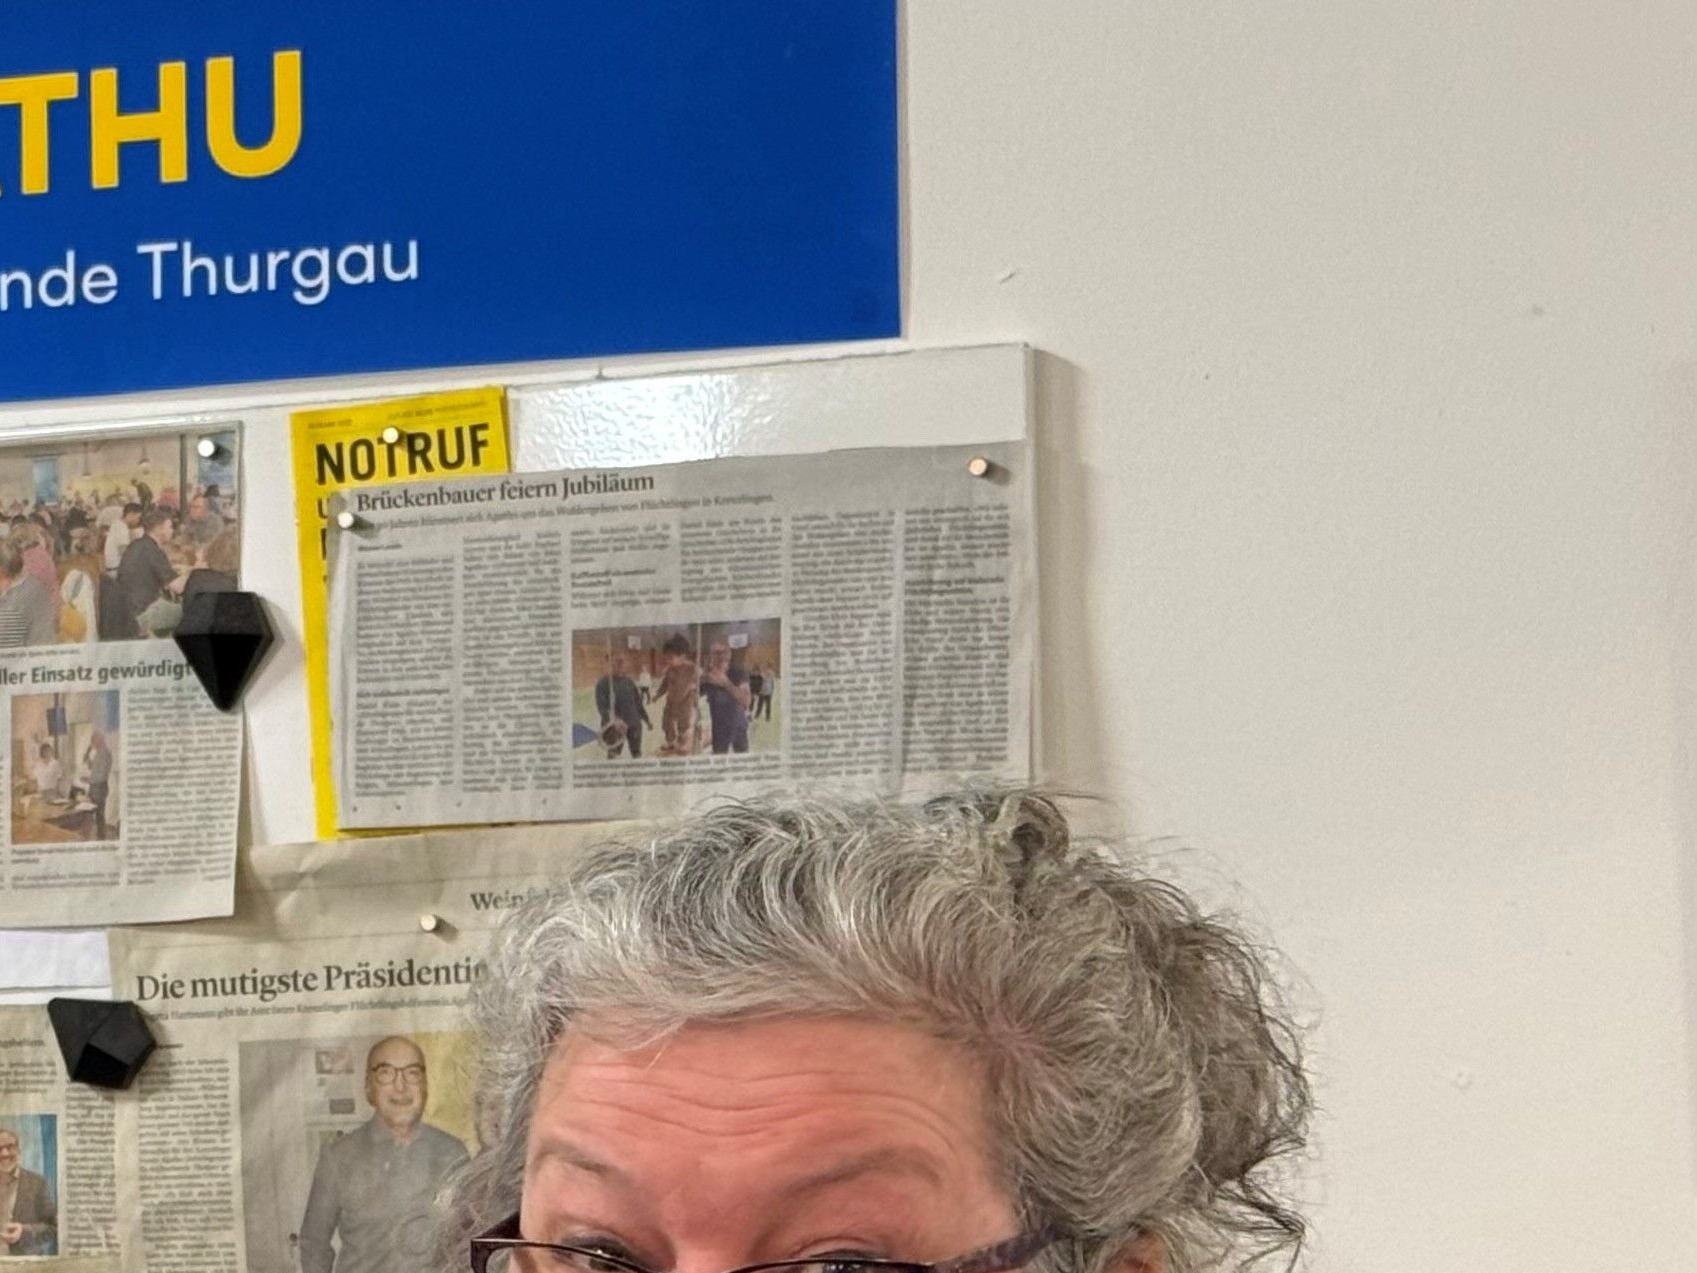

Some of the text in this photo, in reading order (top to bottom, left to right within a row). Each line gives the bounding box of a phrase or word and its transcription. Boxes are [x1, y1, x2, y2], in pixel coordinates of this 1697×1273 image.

[136, 239, 419, 305] Thurgau
[315, 422, 490, 486] NOTRUF
[356, 472, 654, 512] Brückenbauer feiern Jubiläum
[31, 665, 93, 684] Einsatz
[136, 974, 186, 1002] Die
[191, 967, 319, 1002] mutigste
